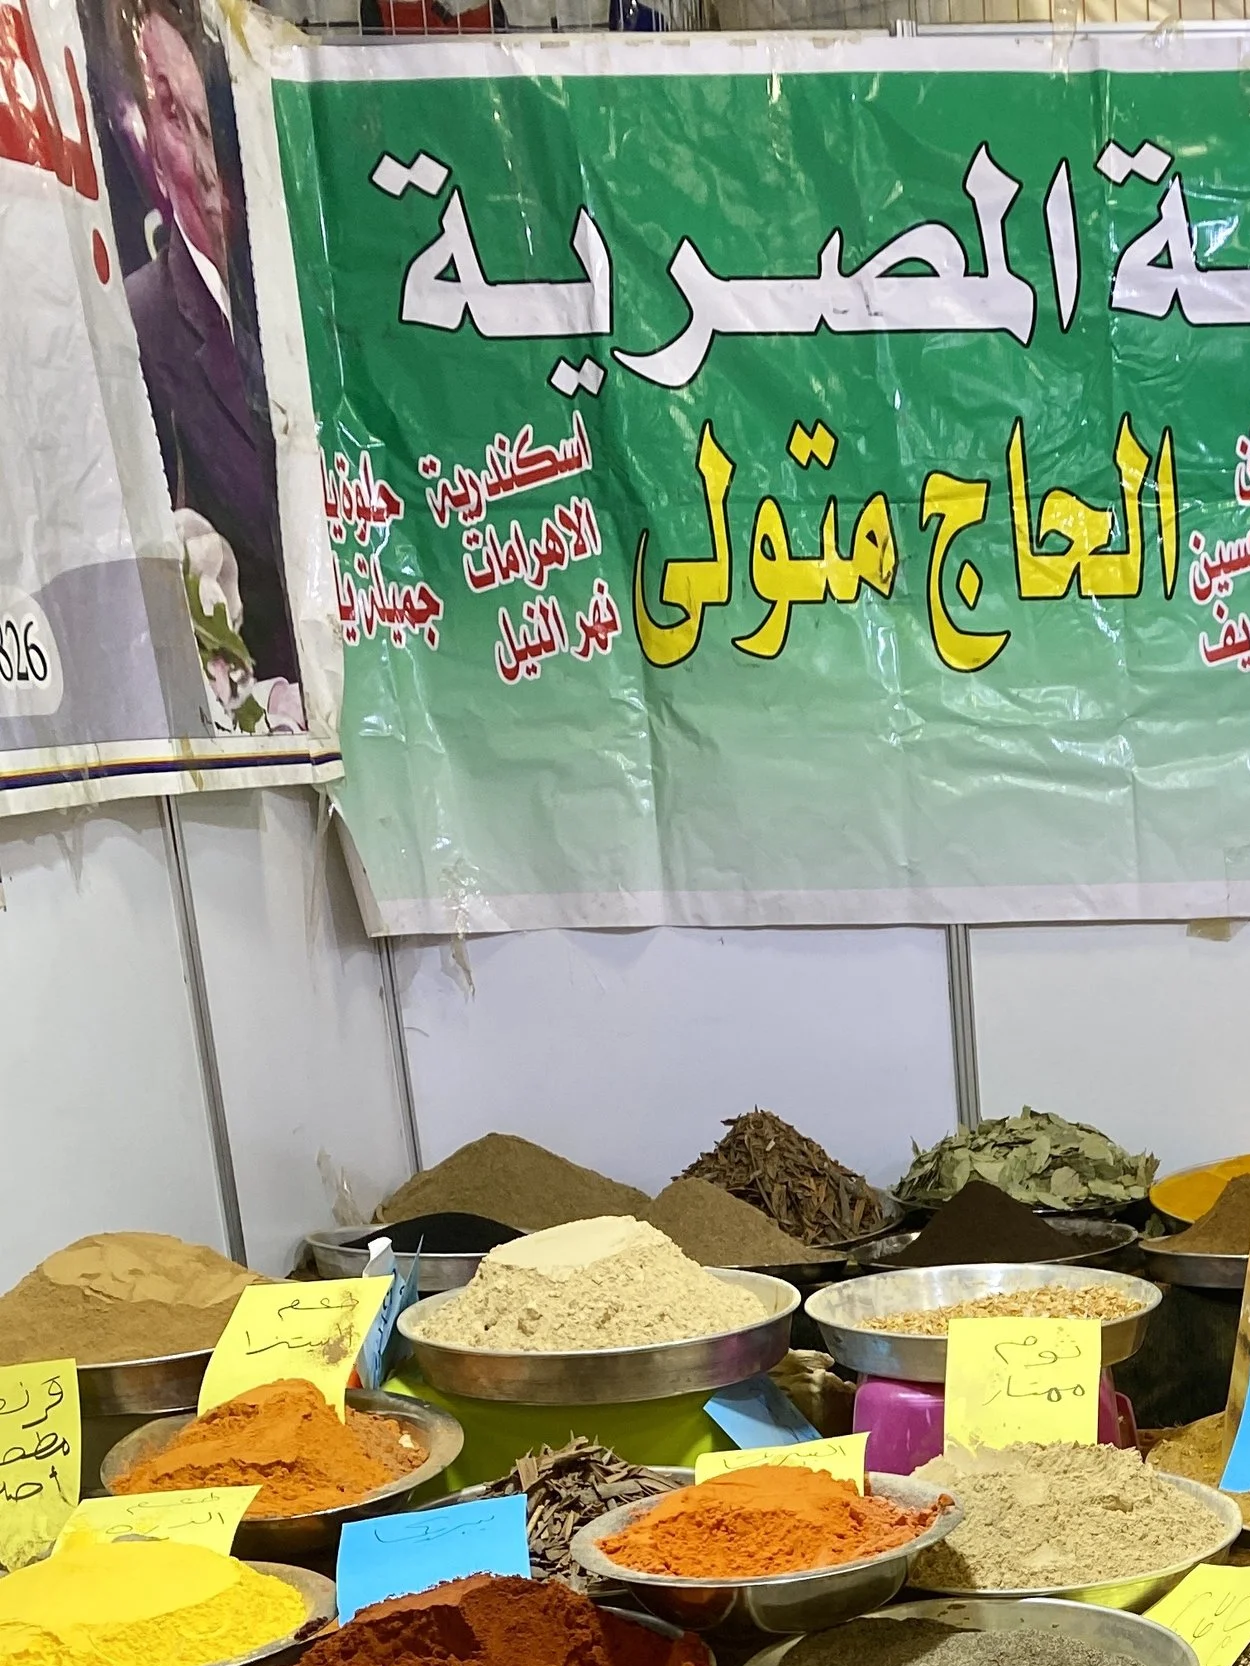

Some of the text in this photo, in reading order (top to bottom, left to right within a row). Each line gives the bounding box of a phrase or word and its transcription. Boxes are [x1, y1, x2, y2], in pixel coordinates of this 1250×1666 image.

[370, 141, 1081, 396] المصرية
[418, 410, 592, 527] اسكندرية
[463, 496, 602, 592] الاهرامات
[919, 411, 1181, 672] الحاج
[495, 578, 622, 685] نهر النيل
